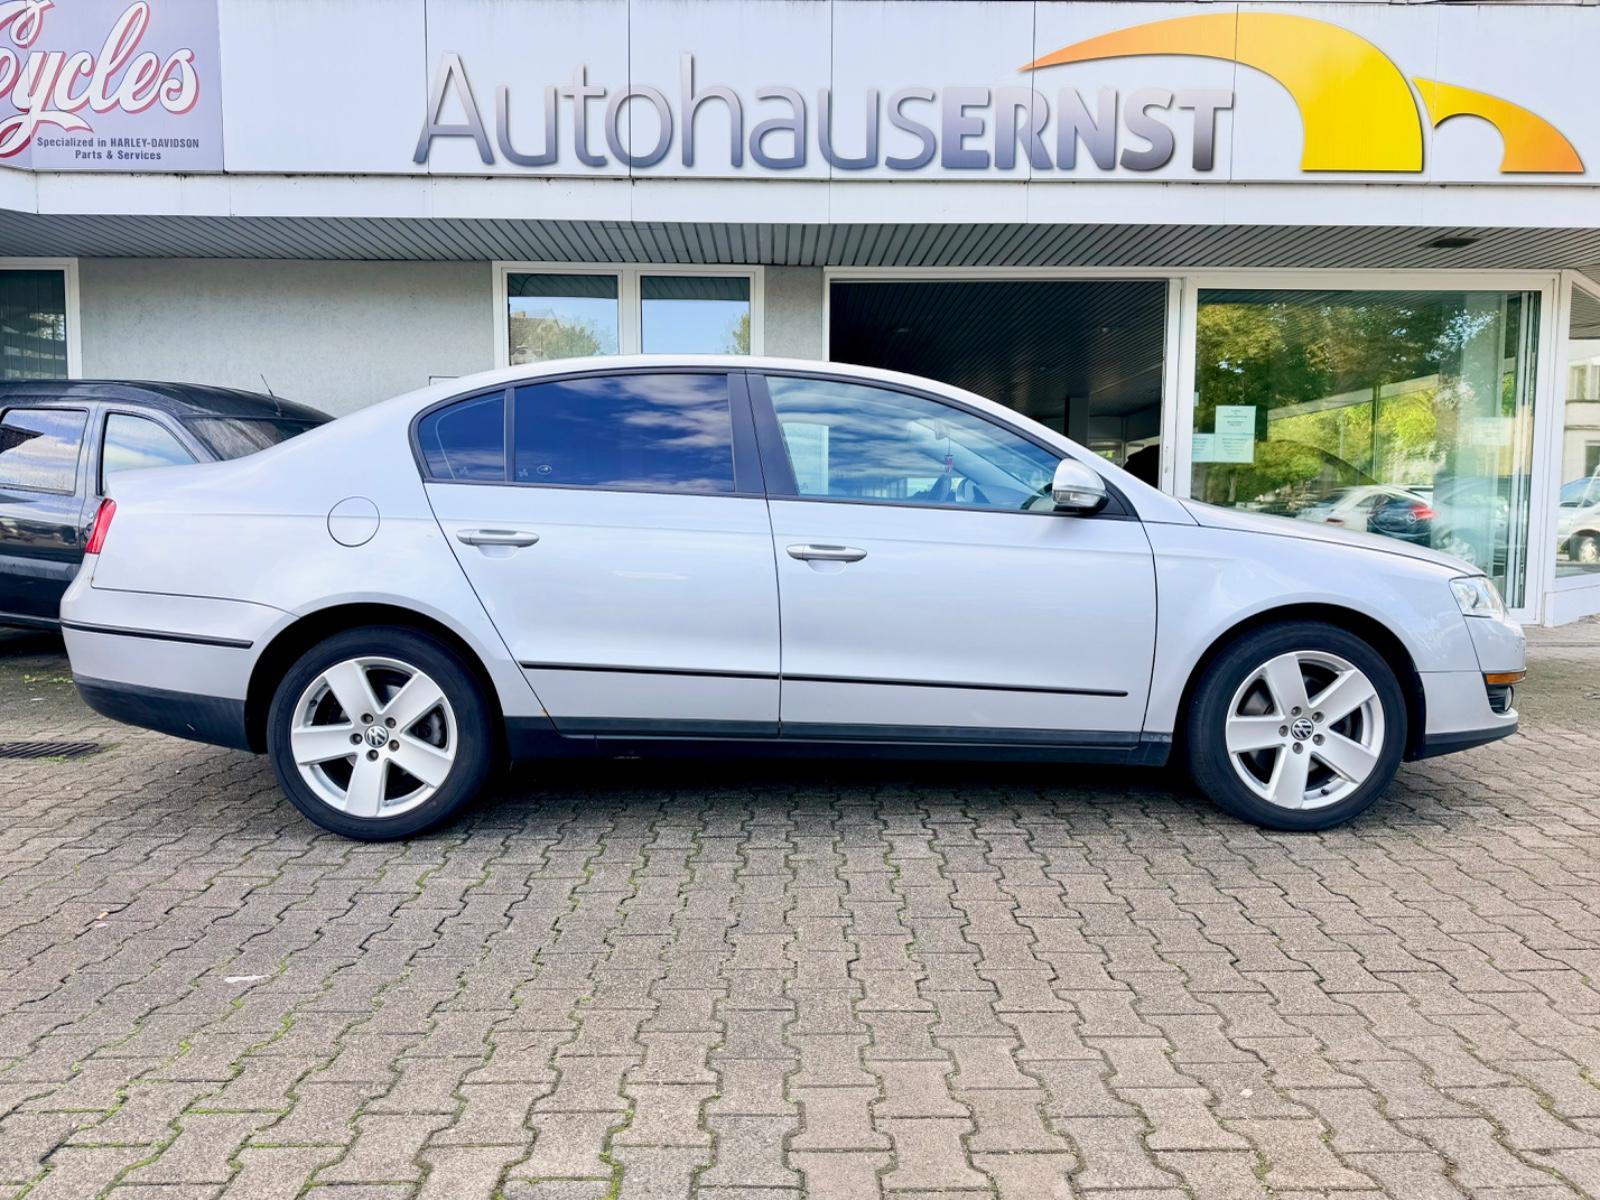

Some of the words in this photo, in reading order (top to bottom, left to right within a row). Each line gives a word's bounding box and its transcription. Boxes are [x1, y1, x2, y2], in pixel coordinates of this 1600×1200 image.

[37, 137, 94, 148] Specialized
[98, 137, 107, 148] in
[110, 138, 199, 148] HARLEY-DAVIDSON
[75, 150, 102, 160] Parts
[106, 151, 113, 160] &
[117, 151, 161, 160] Services
